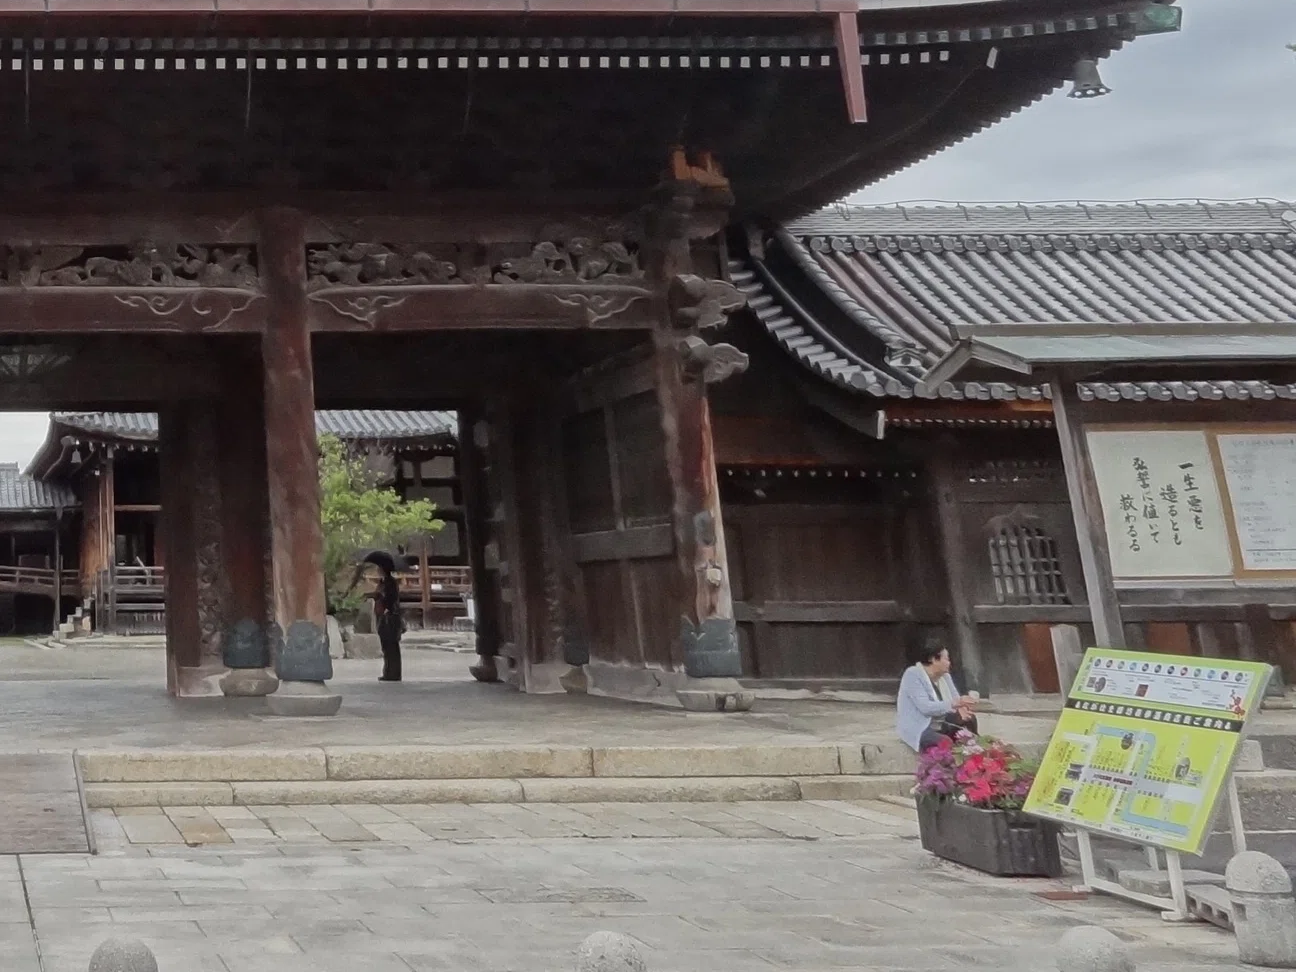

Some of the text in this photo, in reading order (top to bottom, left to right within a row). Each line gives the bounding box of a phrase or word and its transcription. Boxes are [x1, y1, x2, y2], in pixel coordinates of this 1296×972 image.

[1119, 493, 1142, 553] 救わるる
[1131, 457, 1161, 544] 弘誓に値いて
[1159, 484, 1182, 546] 造るとも
